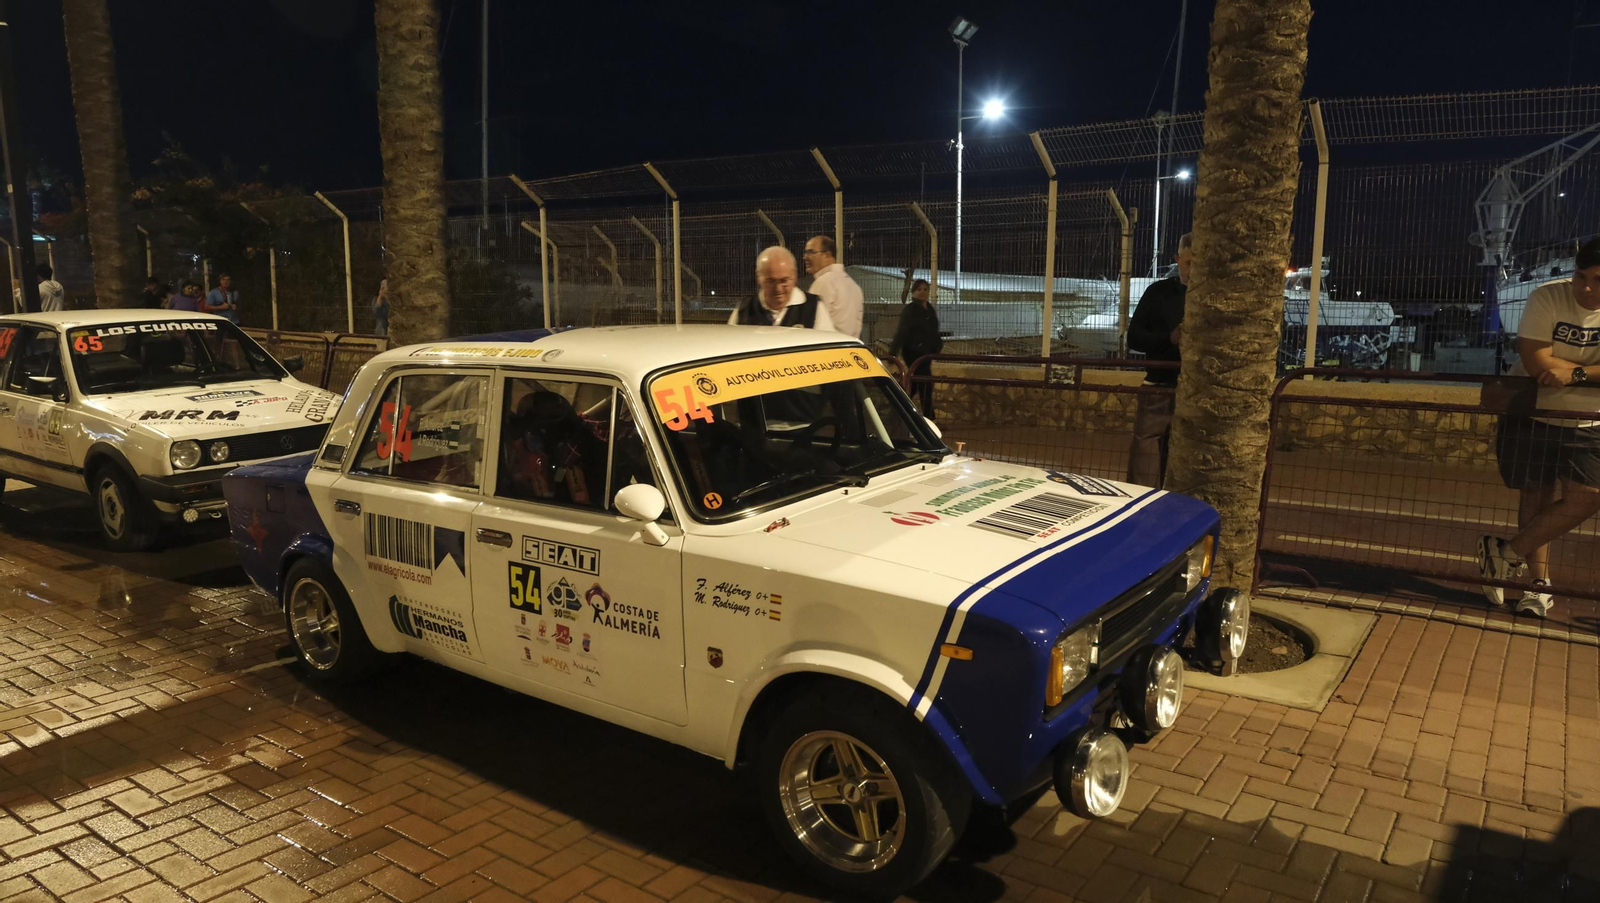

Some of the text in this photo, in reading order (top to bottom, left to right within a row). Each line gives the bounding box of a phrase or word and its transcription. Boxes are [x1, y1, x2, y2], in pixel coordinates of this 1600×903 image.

[96, 325, 137, 337] LOS
[74, 336, 103, 352] 65
[726, 358, 853, 387] AUTOMÓVIL CLUB DE ALMERÍA
[138, 409, 240, 421] MRM
[654, 385, 714, 431] 54
[377, 402, 412, 462] 54
[706, 494, 720, 508] H
[1036, 526, 1061, 538] SEAT
[523, 537, 598, 573] SEAT
[367, 560, 433, 586] www.elagricola.com
[696, 578, 708, 590] F.
[510, 565, 541, 612] 54
[694, 591, 707, 604] M.
[410, 606, 464, 628] HERMANOS
[613, 602, 660, 622] COSTA DE
[412, 612, 468, 643] Mancha
[604, 614, 661, 640] ALMERÍA
